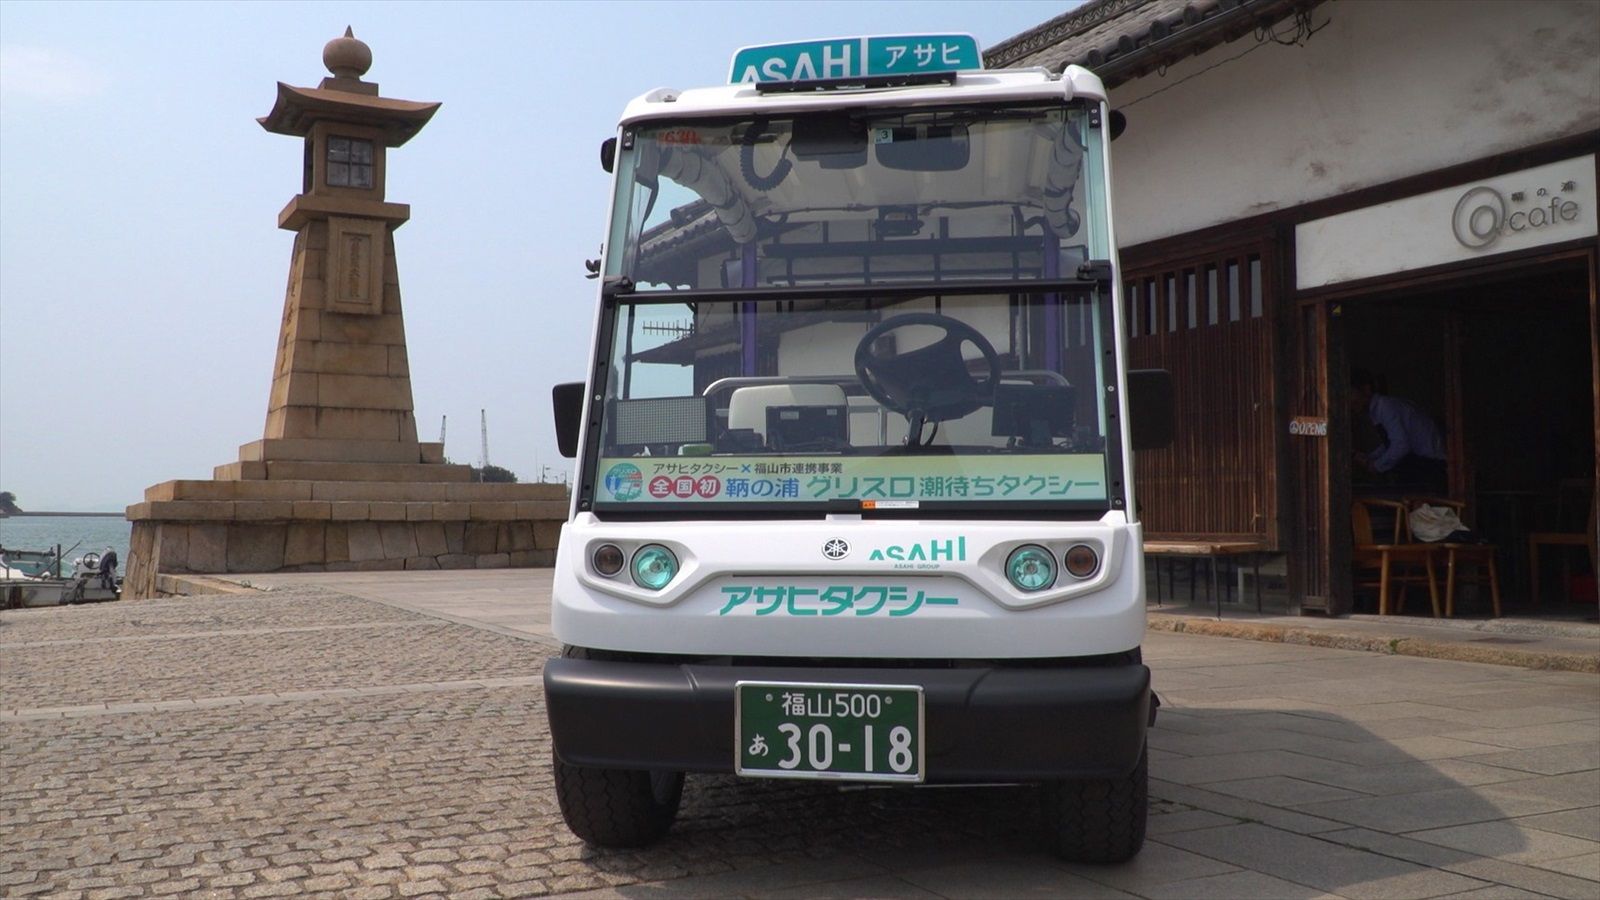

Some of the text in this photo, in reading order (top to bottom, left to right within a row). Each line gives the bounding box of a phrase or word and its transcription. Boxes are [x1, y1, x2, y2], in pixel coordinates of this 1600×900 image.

[885, 42, 961, 68] アサヒ
[649, 475, 1100, 498] 全国初 鞆の浦 グリスロ潮待ちタクシー
[868, 536, 966, 561] ASAHI
[719, 586, 959, 616] アサヒタクシー
[749, 722, 913, 773] あ 30-18
